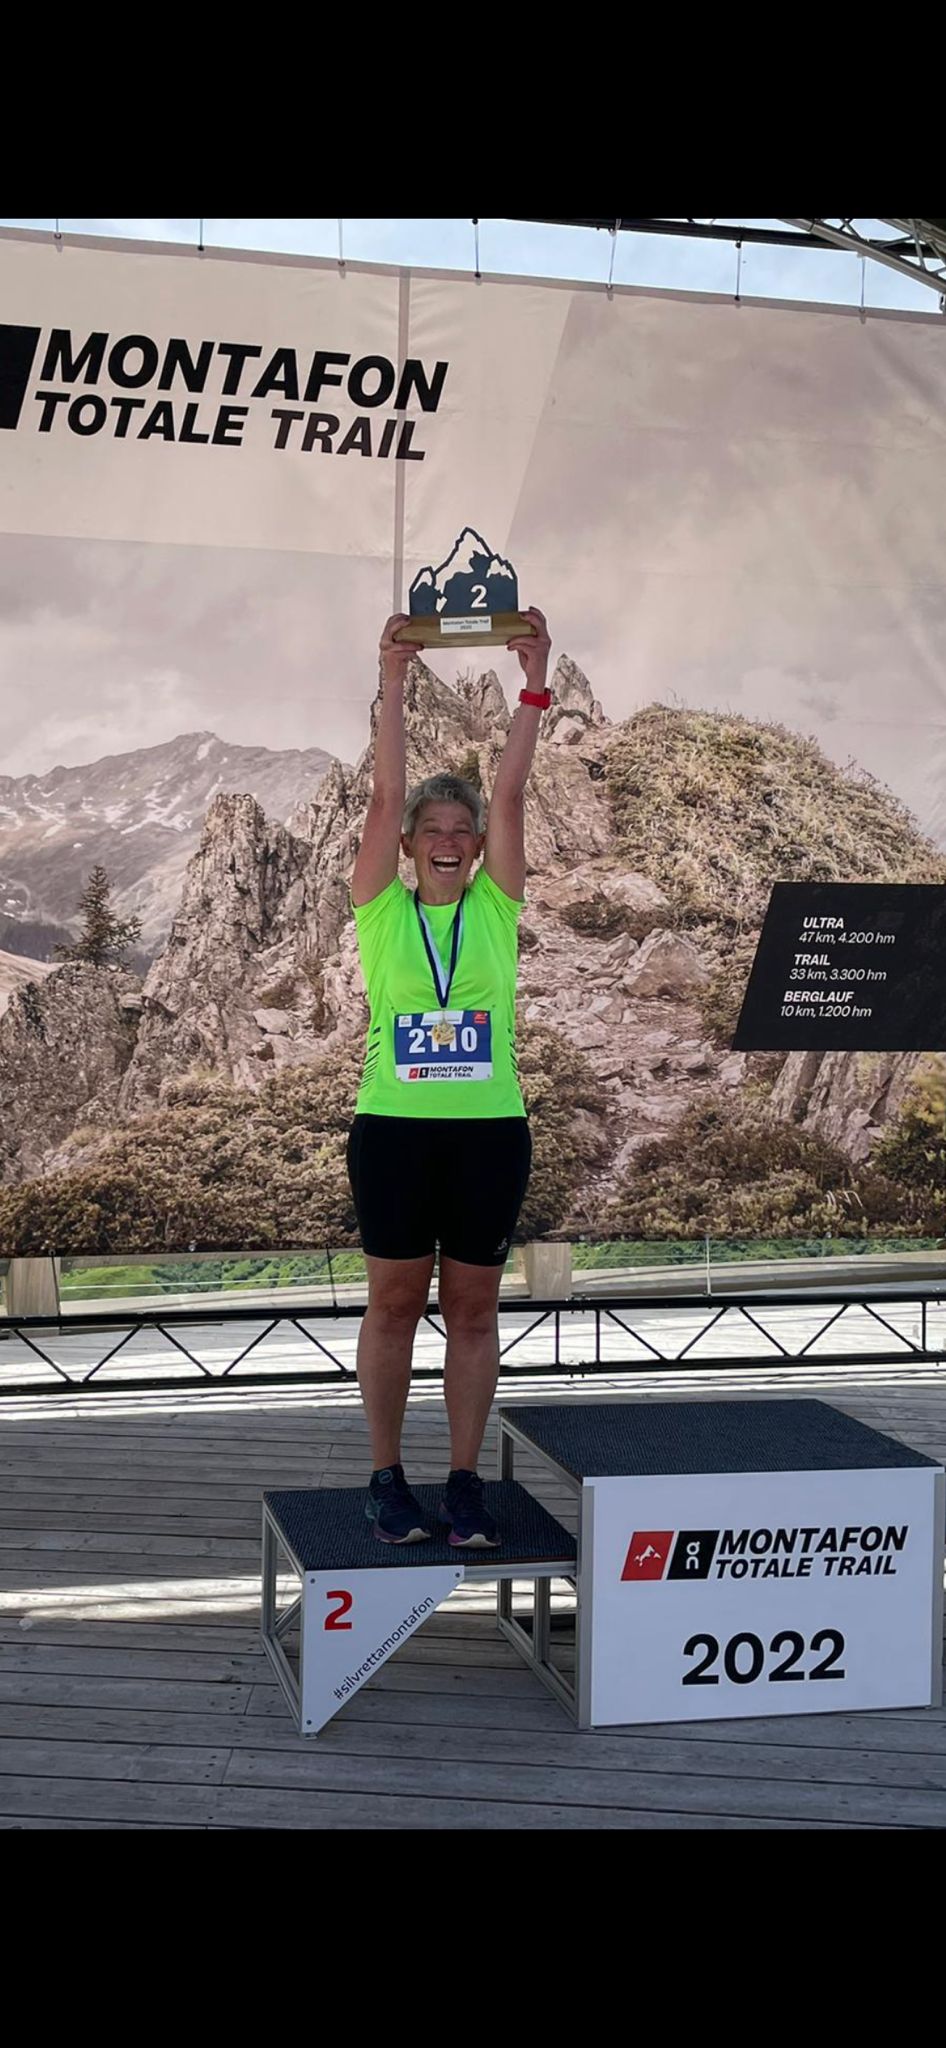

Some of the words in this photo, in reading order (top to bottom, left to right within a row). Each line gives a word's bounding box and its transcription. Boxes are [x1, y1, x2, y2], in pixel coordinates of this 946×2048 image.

[40, 328, 449, 412] MONTAFON
[34, 391, 249, 446] TOTALE
[270, 409, 426, 460] TRAIL
[471, 584, 488, 608] 2
[803, 917, 844, 929] ULTRA
[799, 931, 815, 943] 47
[815, 932, 836, 945] km,
[838, 932, 874, 944] 4.200
[875, 932, 896, 944] hm
[794, 954, 831, 966] TRAIL
[789, 968, 806, 980] 33
[807, 968, 828, 981] km,
[830, 969, 865, 981] 3.300
[866, 969, 887, 980] hm
[783, 991, 855, 1003] BERGLAUF
[781, 1005, 794, 1017] 10
[795, 1005, 816, 1018] km,
[819, 1005, 851, 1017] 1.200
[852, 1005, 872, 1017] hm
[718, 1525, 909, 1556] MONTAFON
[716, 1557, 813, 1580] TOTALE
[823, 1555, 897, 1577] TRAIL
[324, 1590, 353, 1630] 2
[333, 1596, 435, 1700] #silvrettamontafon
[682, 1628, 846, 1686] 2022
